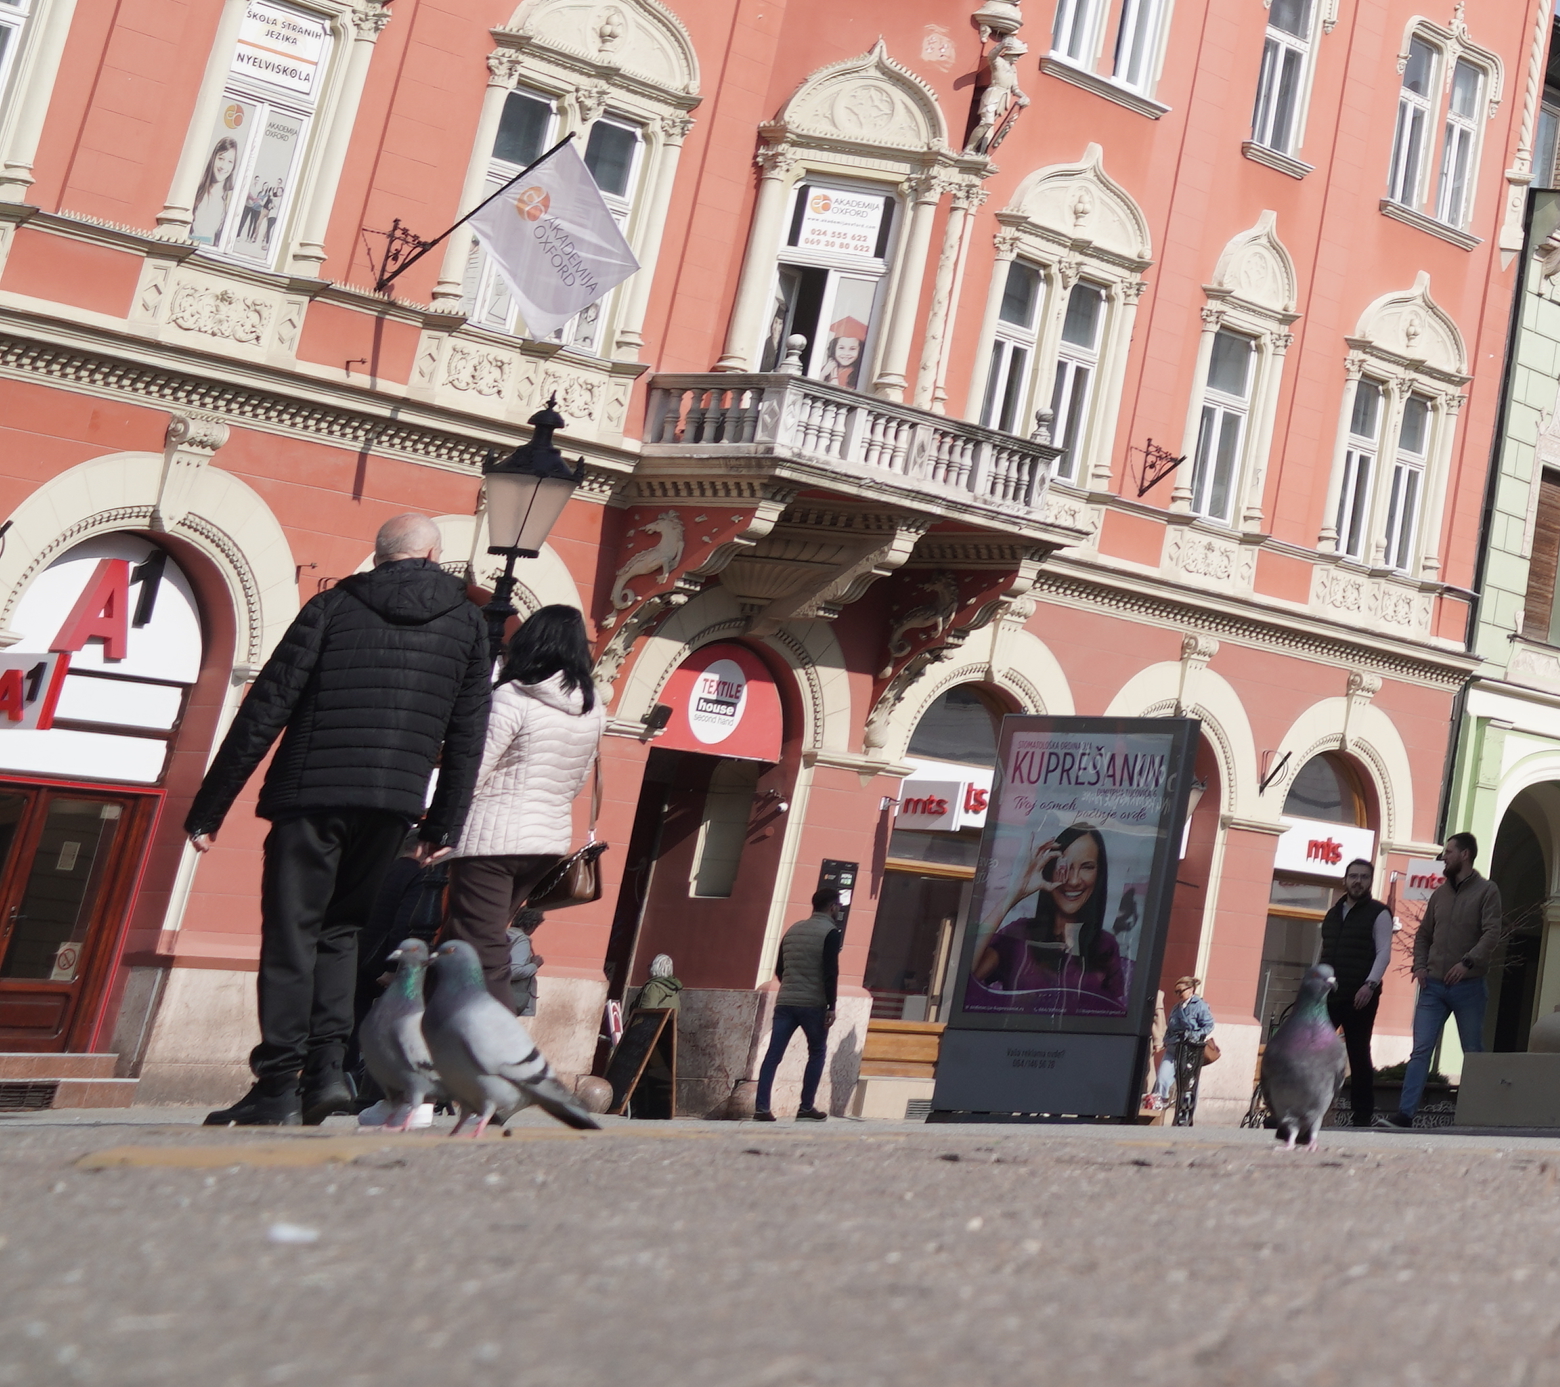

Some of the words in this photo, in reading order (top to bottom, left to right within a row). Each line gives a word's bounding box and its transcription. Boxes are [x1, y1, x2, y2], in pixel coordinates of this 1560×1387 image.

[246, 10, 277, 26] ŠKOLA
[281, 21, 322, 40] STRANIH
[264, 29, 298, 45] JEZIKA
[236, 52, 311, 83] NYELVISKOLA
[265, 129, 290, 142] OXFORD
[832, 207, 869, 218] OXFORD
[833, 198, 880, 211] AKADEMIJA
[533, 225, 576, 288] OXFORD
[544, 216, 599, 296] AKADEMIJA
[48, 549, 168, 662] A1
[0, 662, 47, 721] A1
[702, 678, 742, 699] TEXTILE
[698, 699, 735, 715] house
[693, 713, 717, 724] second
[718, 716, 735, 727] hand
[1011, 746, 1164, 788] KUPREŠANIN
[903, 794, 948, 815] mts
[963, 782, 988, 813] ts
[1013, 795, 1038, 816] Tvoj
[1040, 797, 1079, 812] osmeh
[1120, 806, 1147, 822] ovde
[1306, 837, 1343, 864] mts
